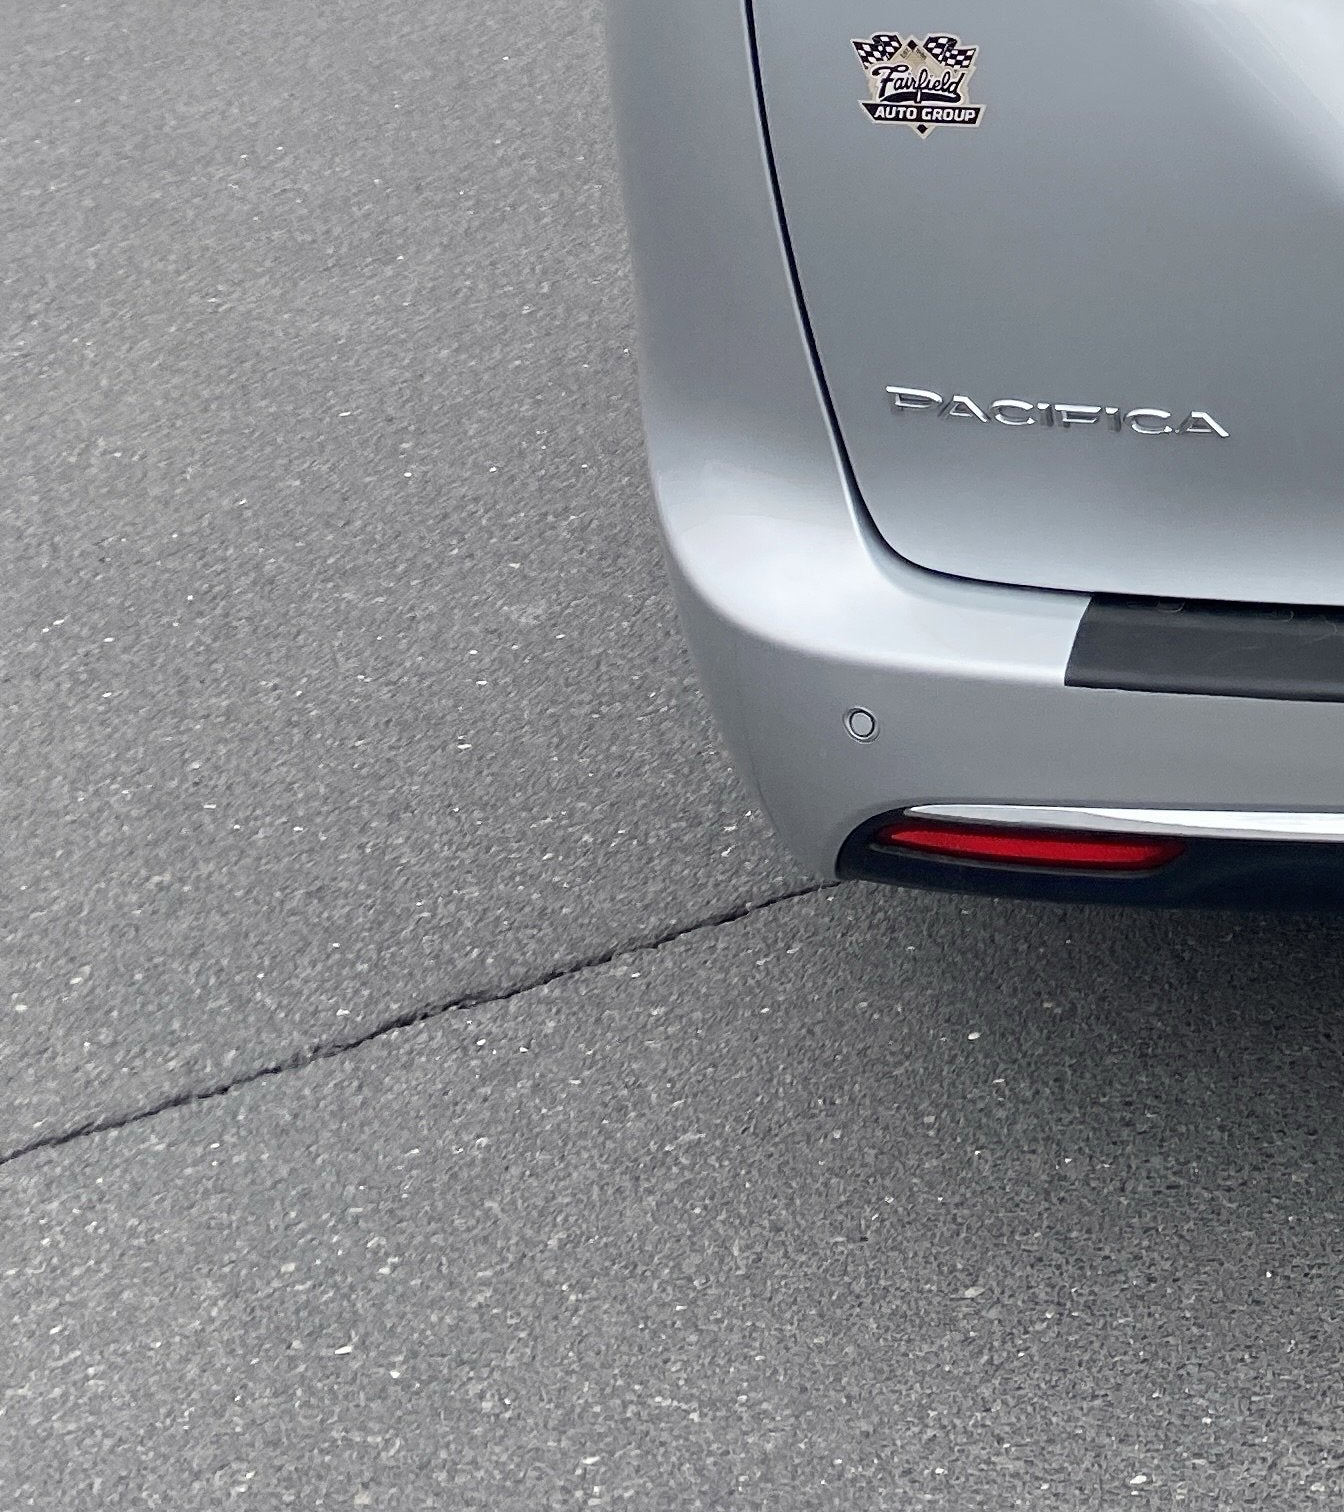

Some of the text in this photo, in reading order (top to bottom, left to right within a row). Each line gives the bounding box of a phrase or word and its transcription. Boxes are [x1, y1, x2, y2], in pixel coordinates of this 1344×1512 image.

[871, 64, 966, 104] Fairfield
[873, 105, 976, 122] AUTO GROUP
[885, 384, 1230, 439] PACIFICA
